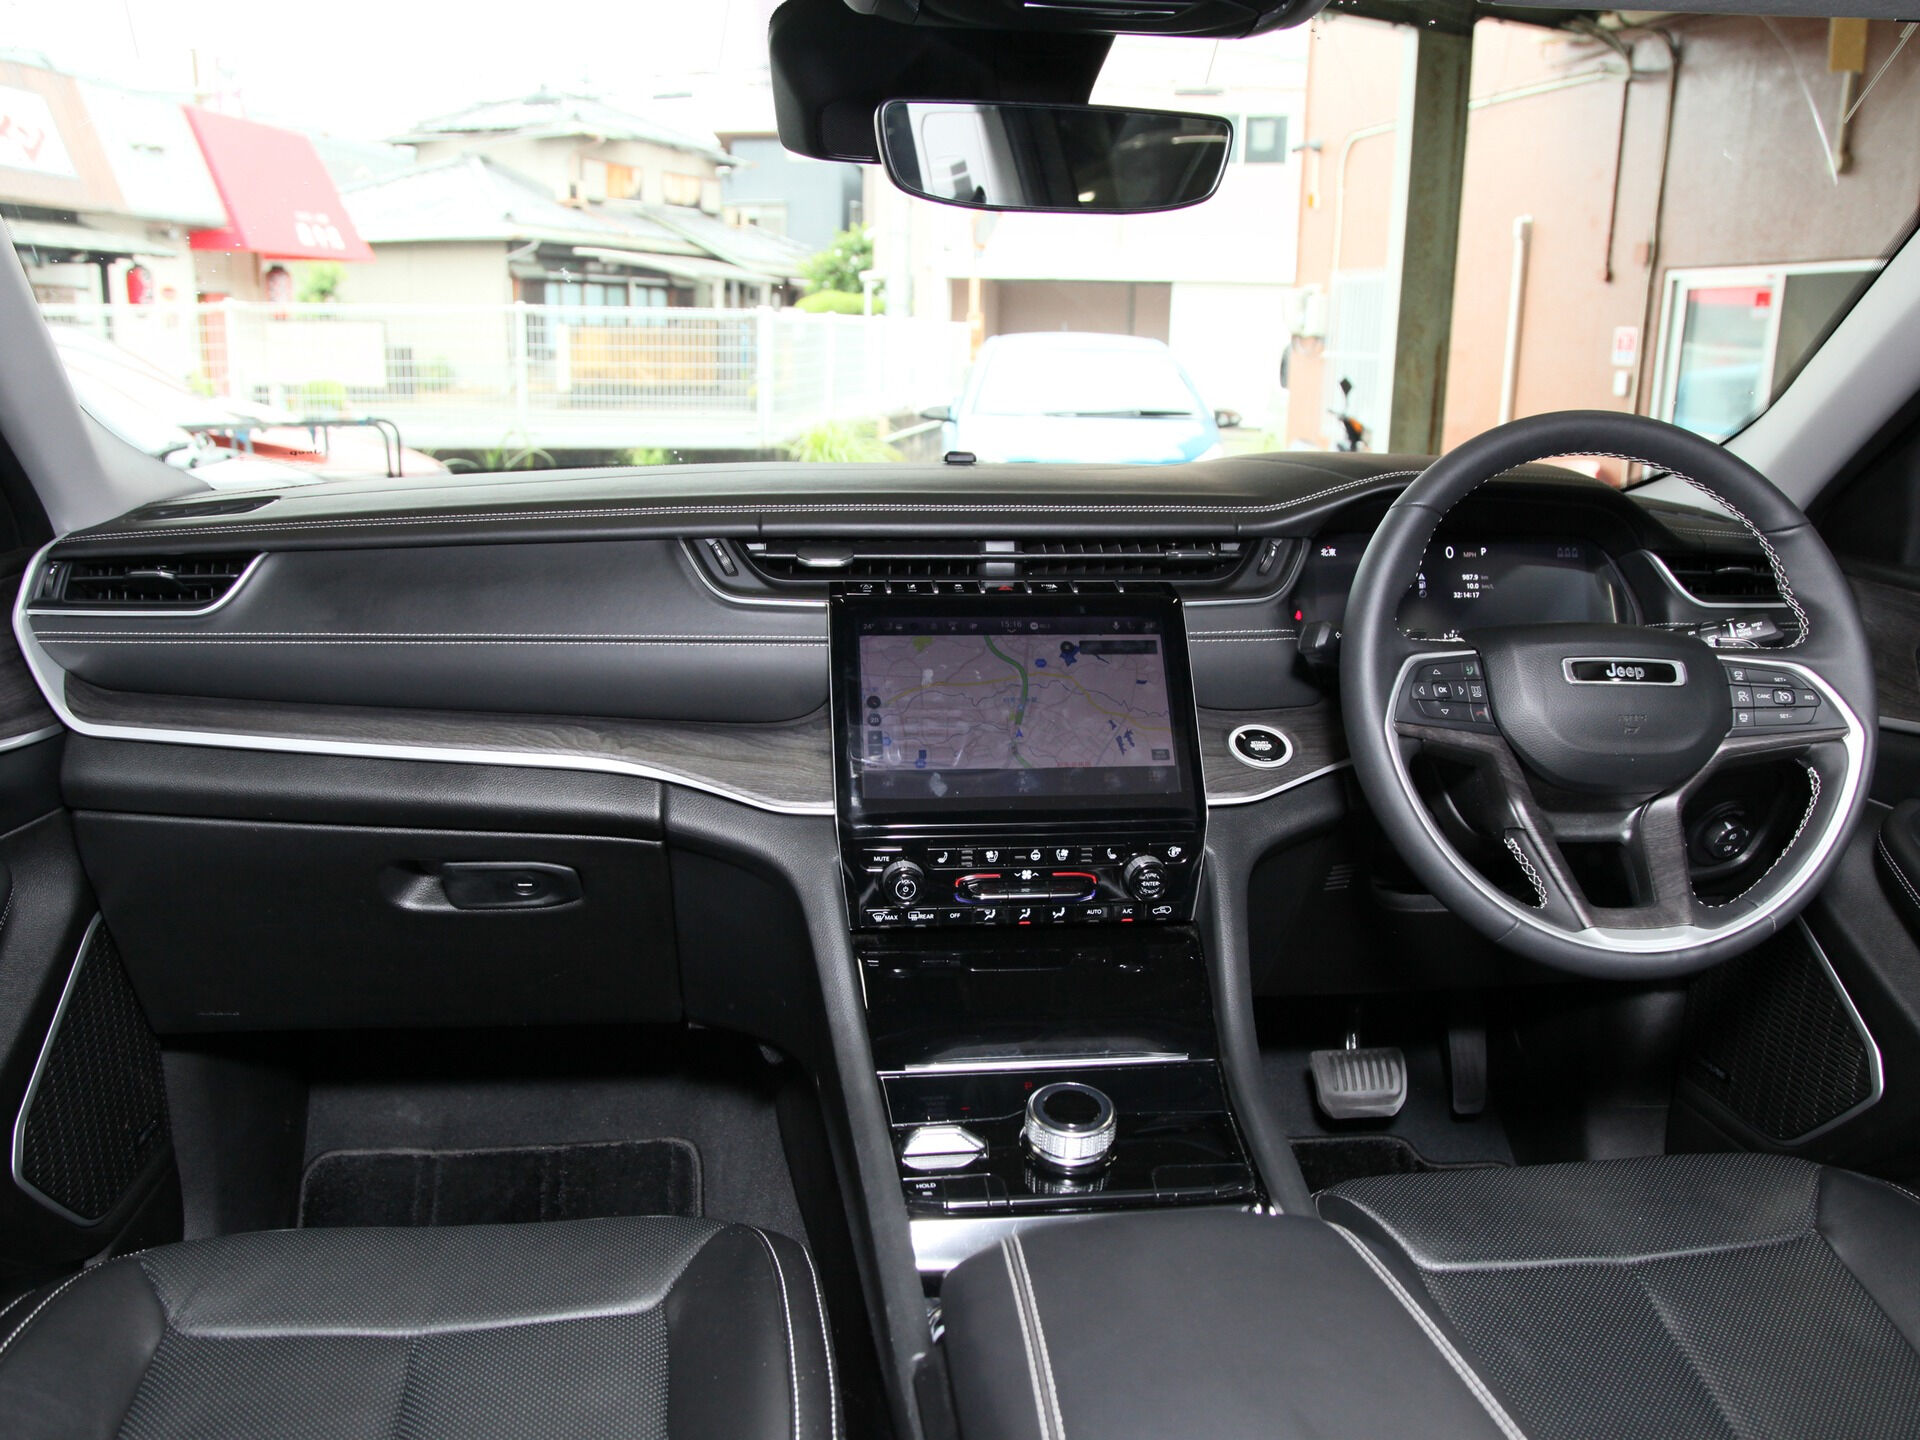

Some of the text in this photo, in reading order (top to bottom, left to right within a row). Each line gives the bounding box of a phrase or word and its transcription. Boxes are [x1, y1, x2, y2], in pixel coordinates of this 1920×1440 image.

[1480, 547, 1487, 556] P
[1606, 663, 1645, 680] Jeep
[916, 1182, 936, 1190] HOLD
